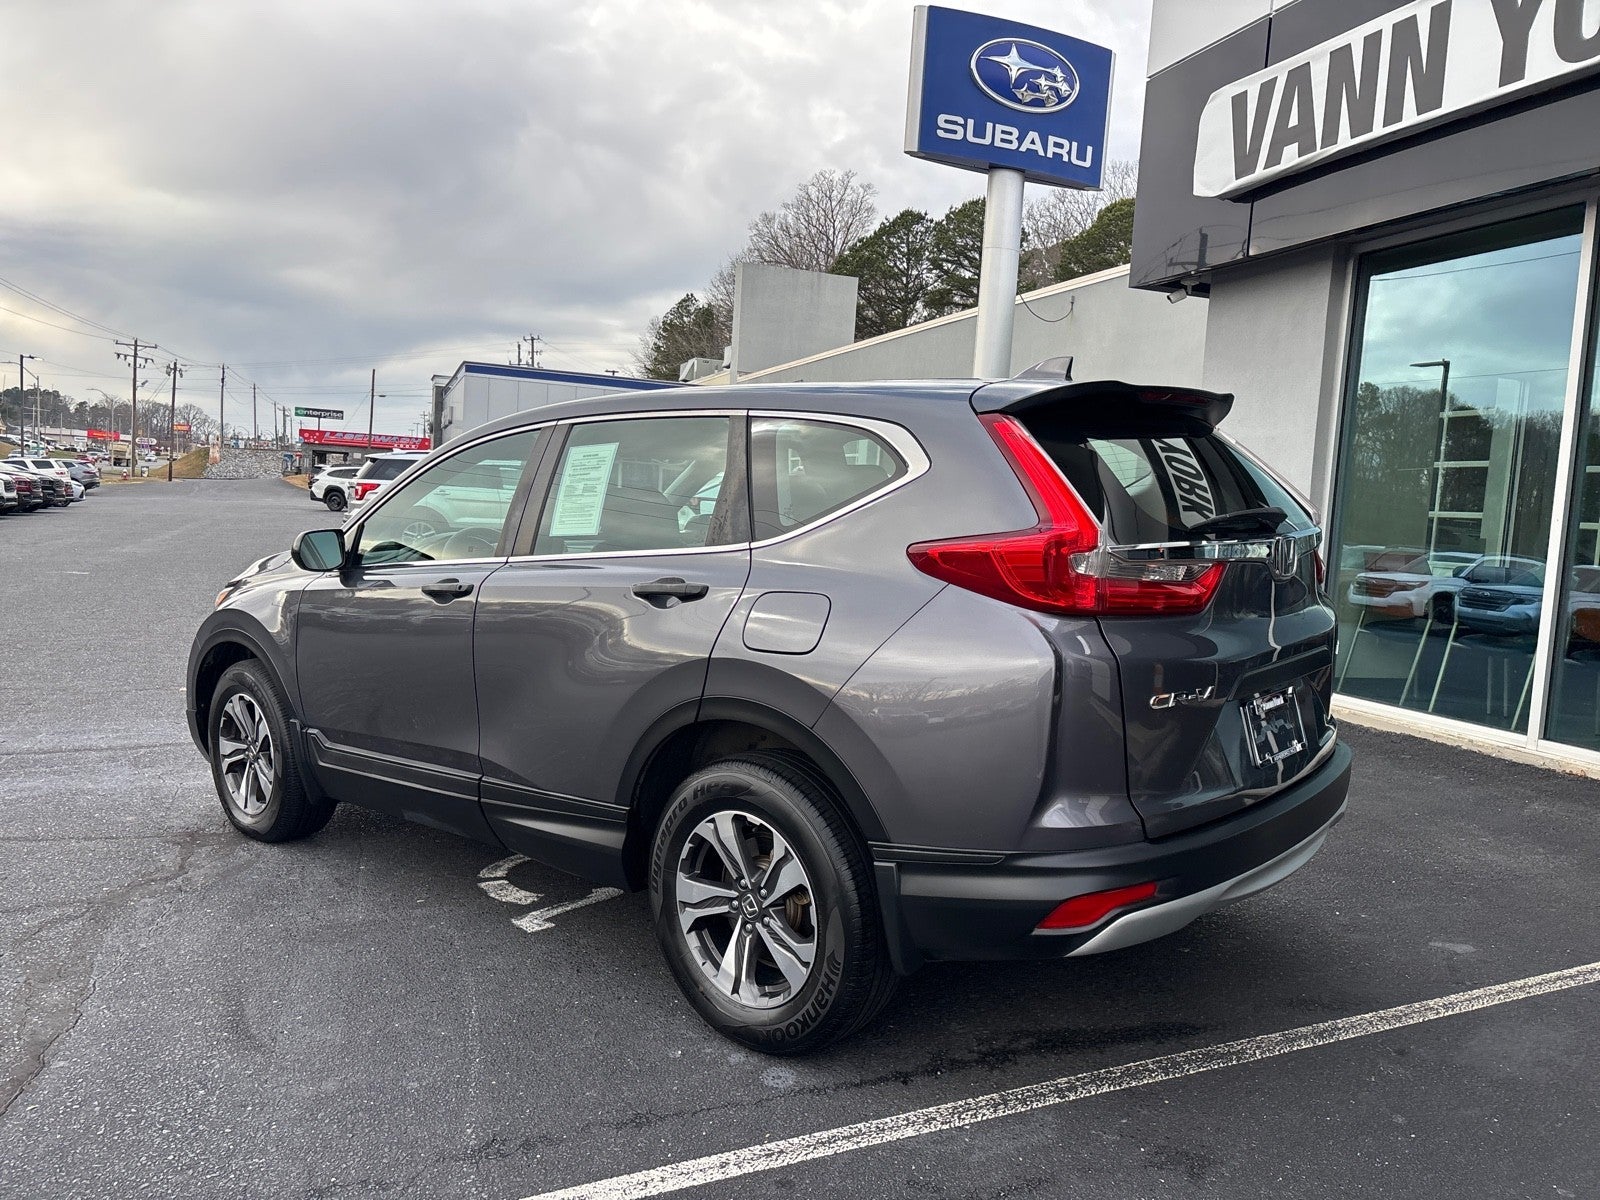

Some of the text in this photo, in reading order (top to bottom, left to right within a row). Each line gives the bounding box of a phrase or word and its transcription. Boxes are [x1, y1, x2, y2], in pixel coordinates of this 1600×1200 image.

[1231, 0, 1452, 180] VANN
[937, 113, 1093, 168] SUBARU
[296, 408, 343, 418] enterprise
[1150, 686, 1215, 710] CR-V
